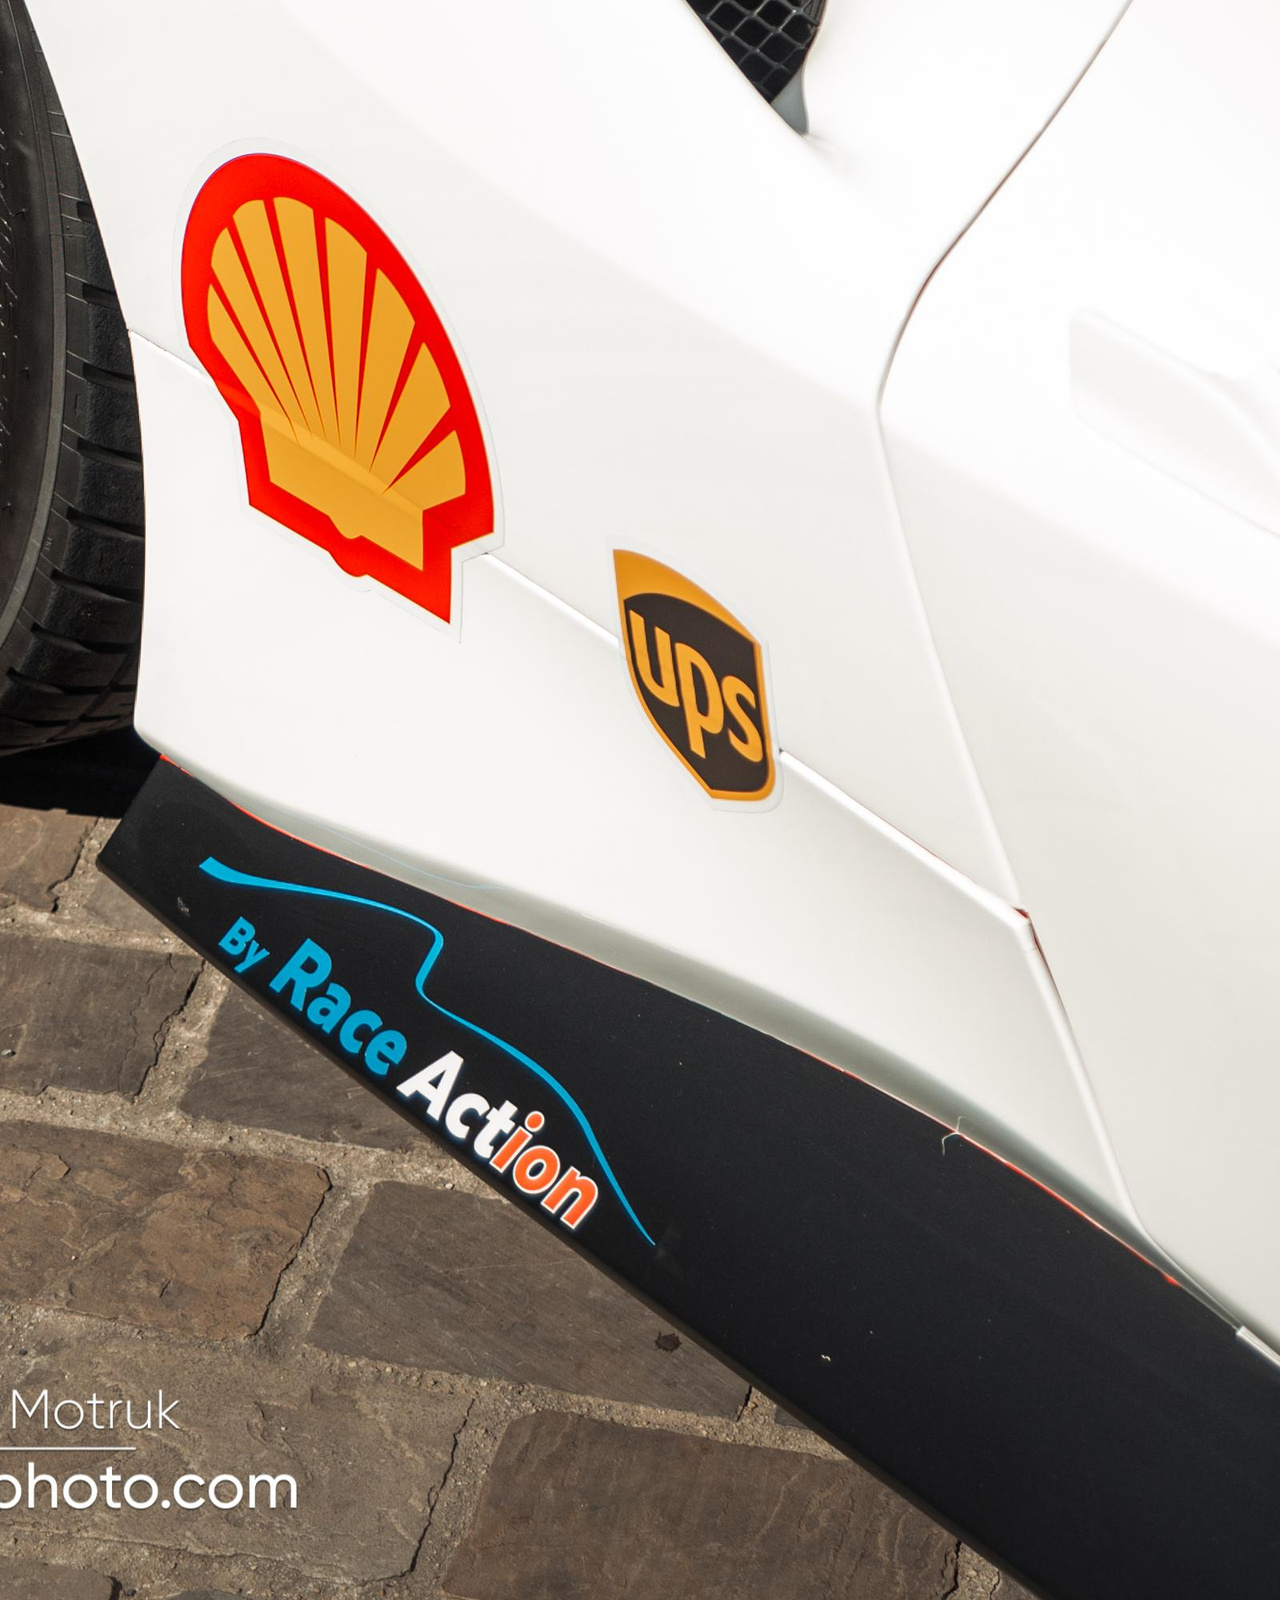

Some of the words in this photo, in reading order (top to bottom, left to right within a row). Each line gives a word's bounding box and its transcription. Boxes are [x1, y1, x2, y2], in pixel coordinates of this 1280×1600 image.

[629, 610, 764, 763] ups
[218, 916, 270, 974] By
[269, 938, 407, 1076] Race
[396, 1050, 599, 1230] Action
